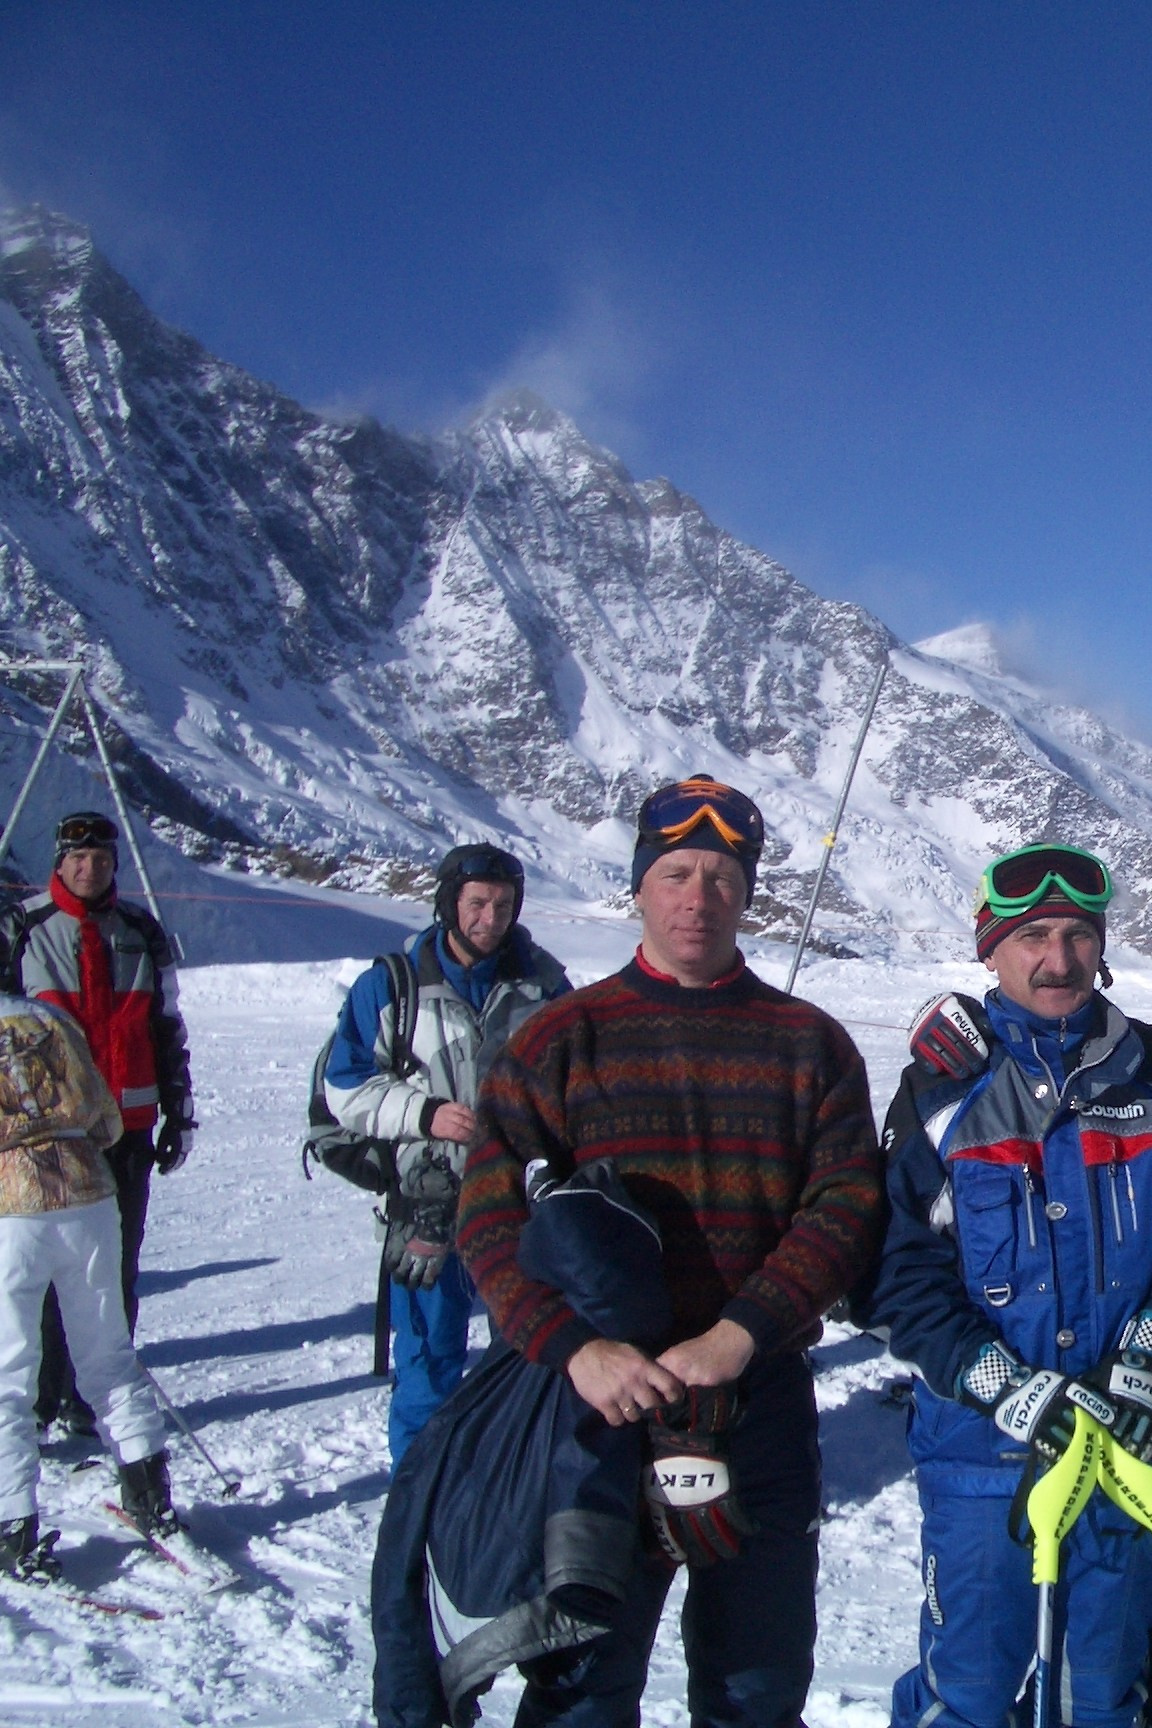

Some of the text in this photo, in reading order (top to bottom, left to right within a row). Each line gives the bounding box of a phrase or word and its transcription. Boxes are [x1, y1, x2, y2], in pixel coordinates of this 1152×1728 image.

[1013, 1374, 1051, 1430] reusch
[1072, 1389, 1111, 1421] racing
[1054, 1432, 1095, 1539] KOMPERDELL
